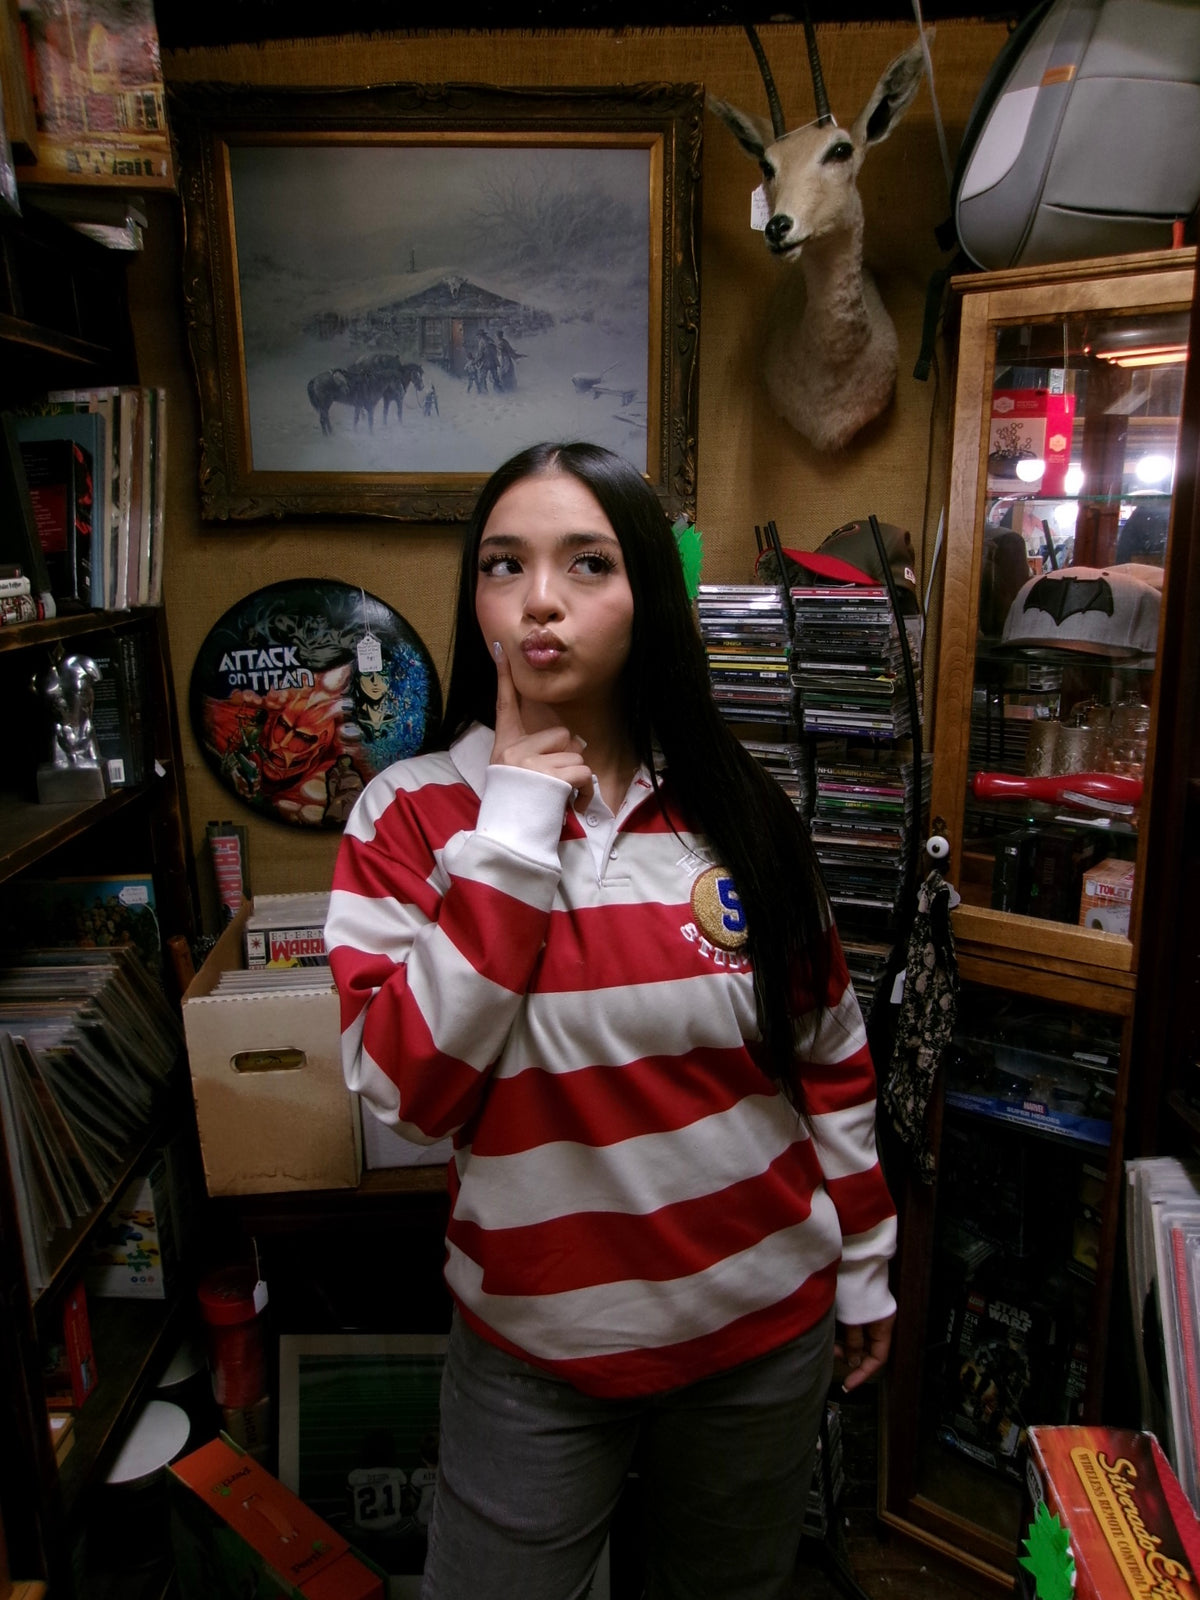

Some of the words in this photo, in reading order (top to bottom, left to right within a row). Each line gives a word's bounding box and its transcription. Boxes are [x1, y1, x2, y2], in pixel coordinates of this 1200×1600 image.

[218, 646, 301, 672] ATTACK
[228, 672, 247, 686] on
[988, 1299, 1031, 1320] STAR
[988, 1310, 1033, 1333] WARS
[357, 1485, 396, 1520] 21
[1097, 1452, 1163, 1552] Silverado
[1078, 1453, 1107, 1498] WIRELESS
[1099, 1499, 1125, 1539] REMOTE
[1117, 1541, 1148, 1588] CONTROL
